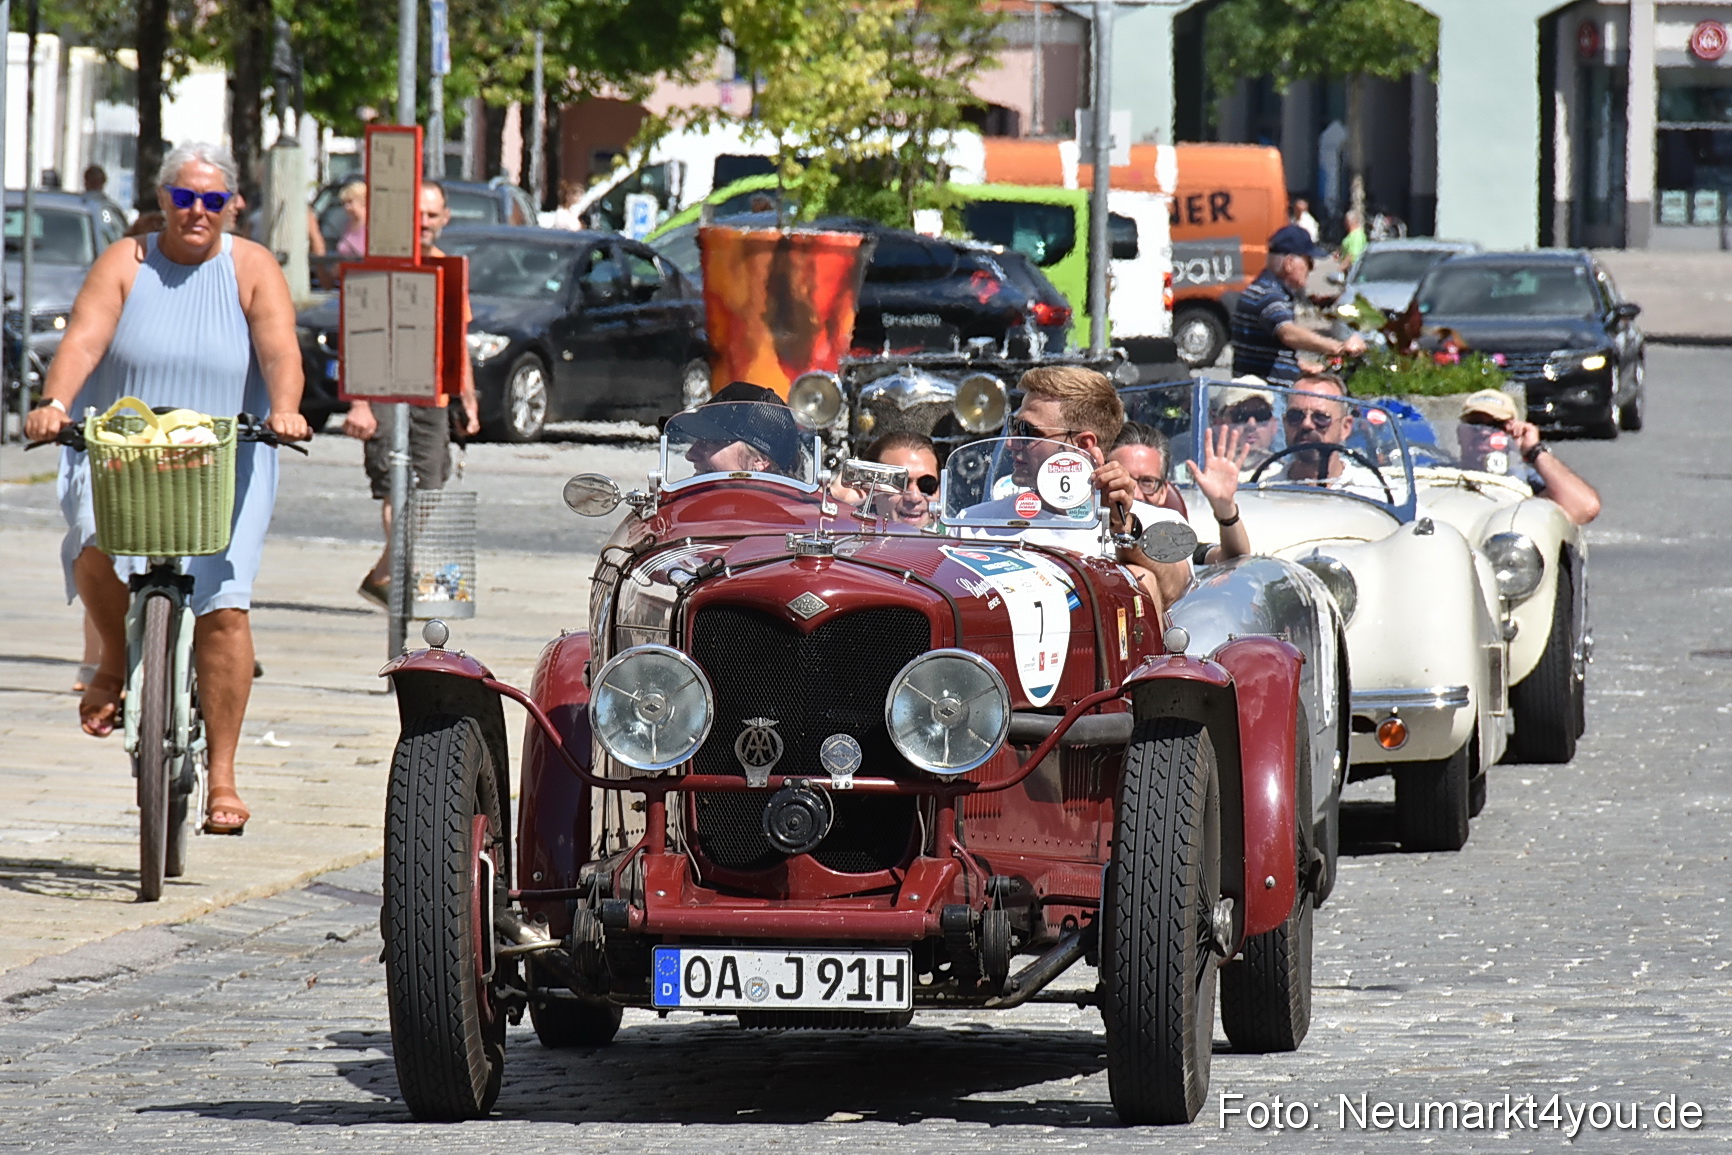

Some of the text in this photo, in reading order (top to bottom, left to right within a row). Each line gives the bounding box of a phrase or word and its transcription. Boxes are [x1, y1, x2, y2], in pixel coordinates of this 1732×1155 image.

[1060, 475, 1071, 493] 6
[1034, 601, 1044, 643] 7
[662, 983, 673, 997] D
[684, 955, 905, 1003] OA J 91H
